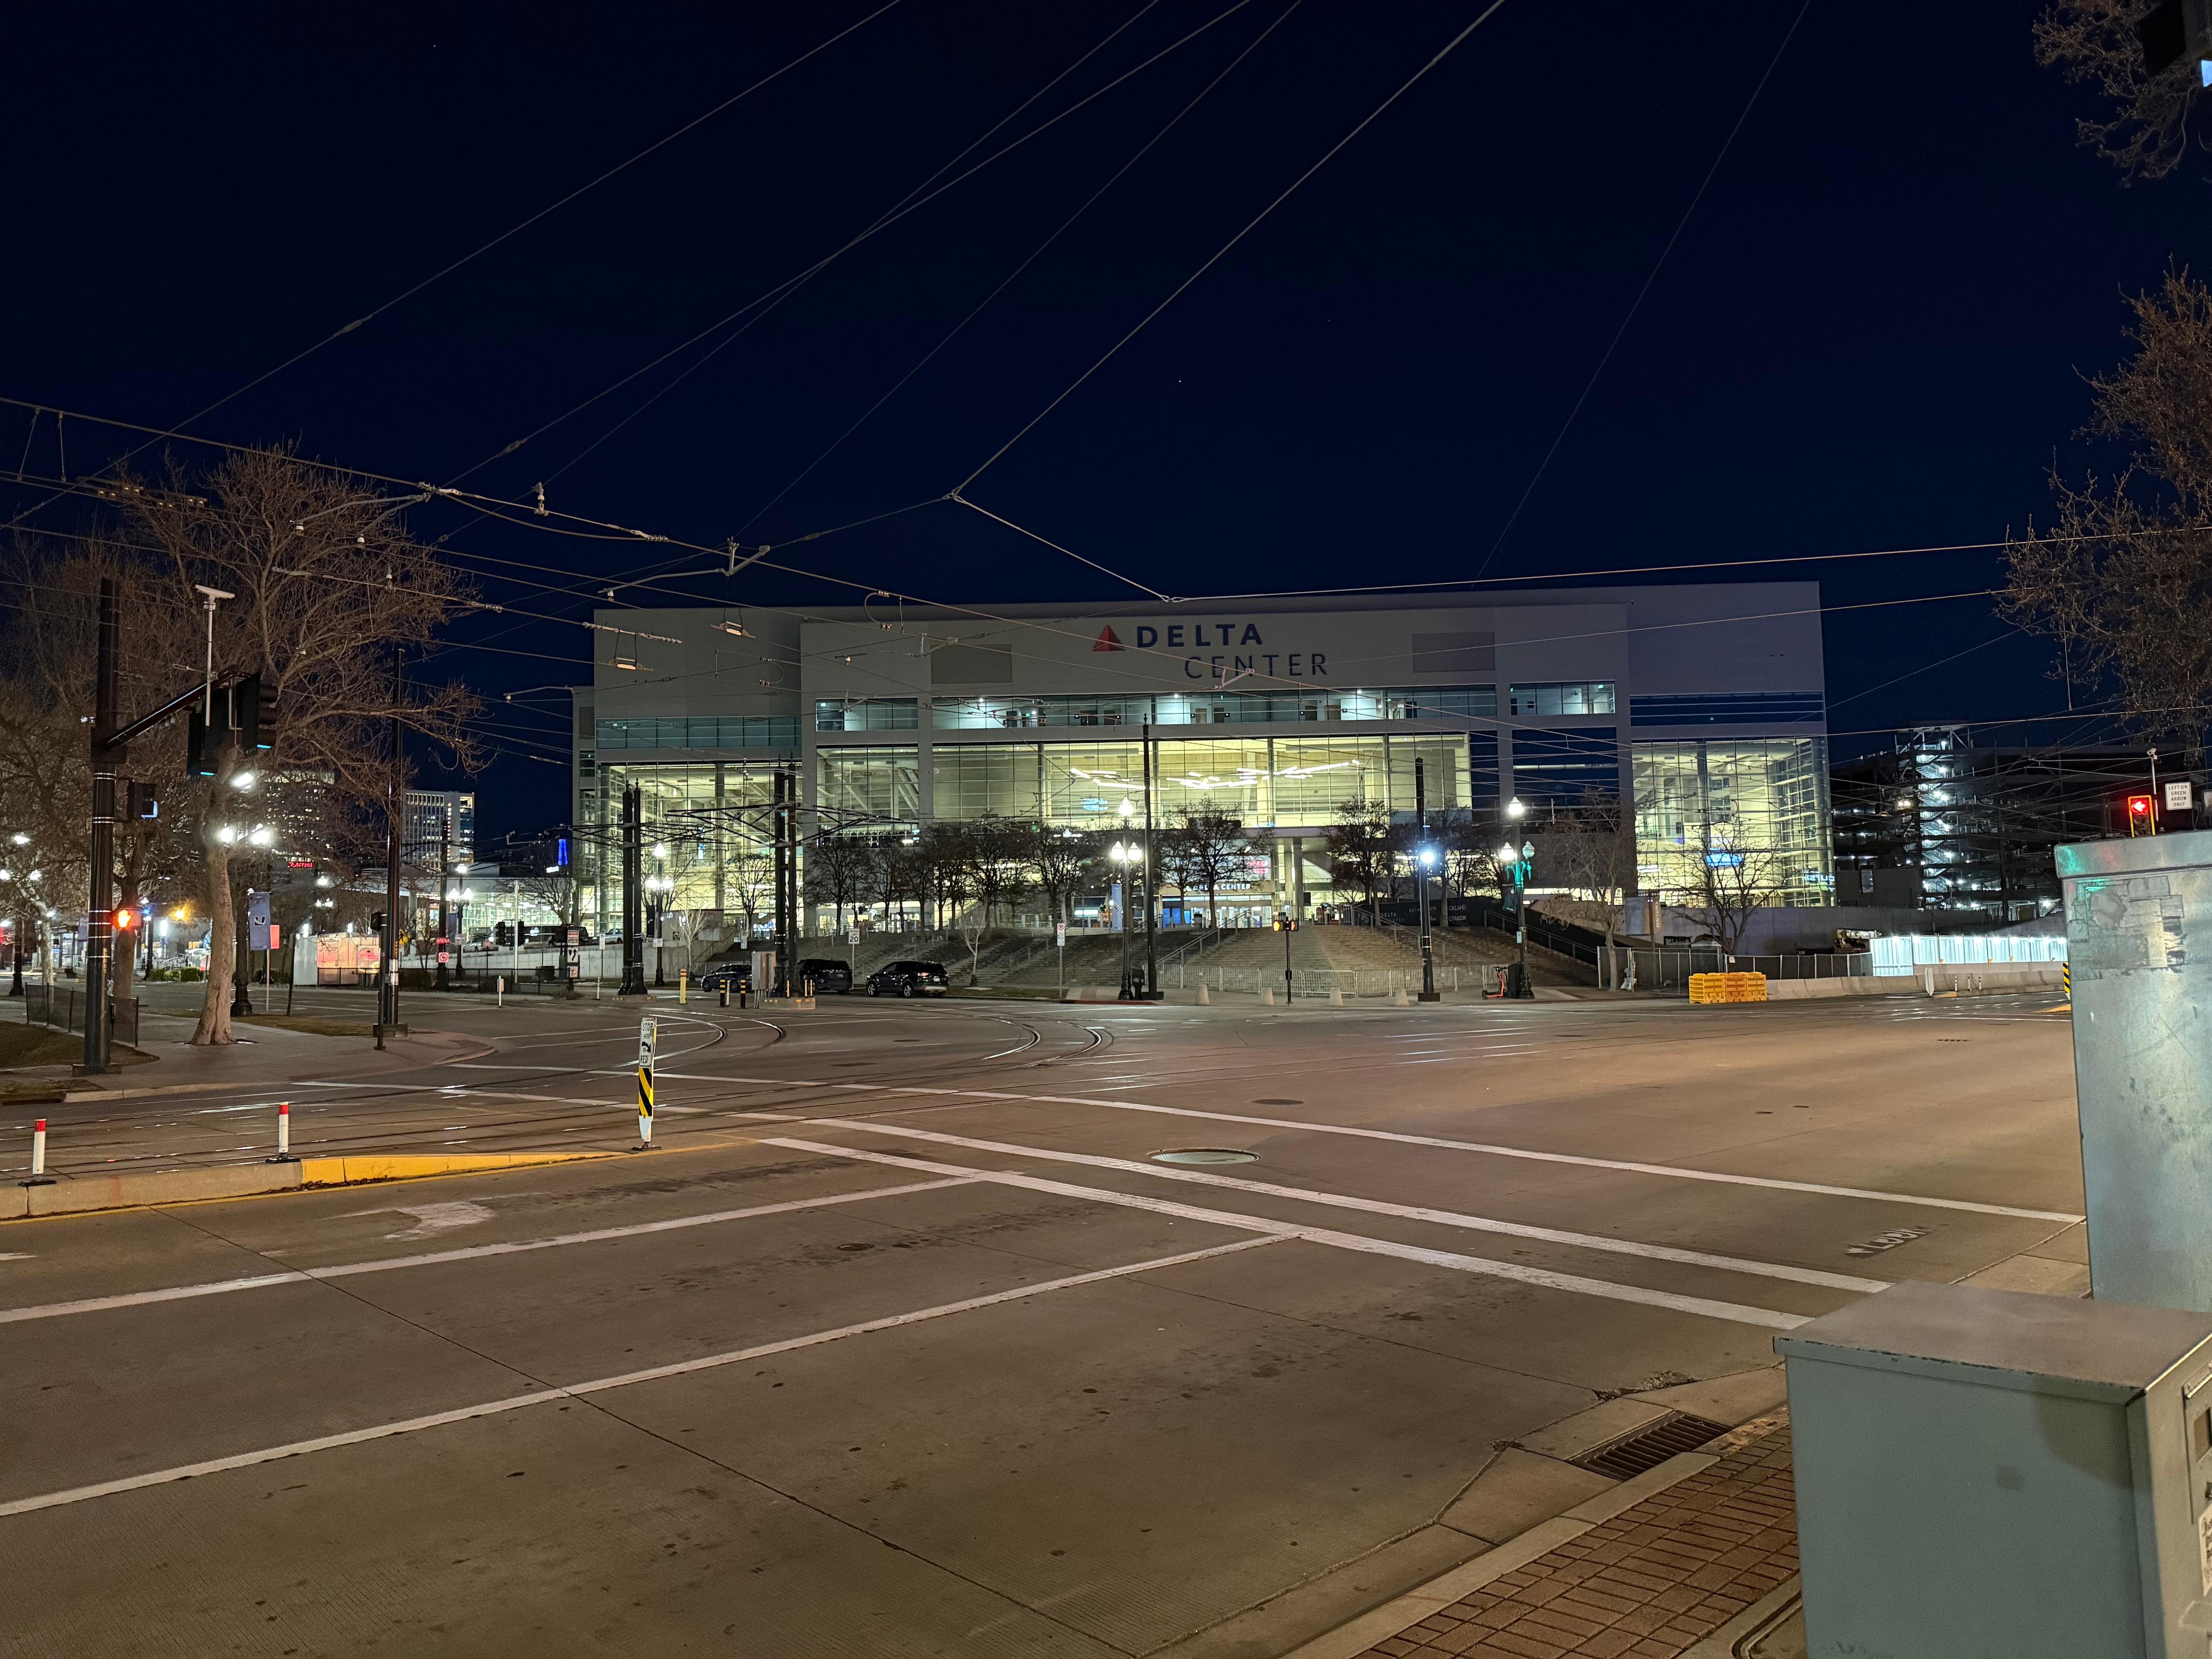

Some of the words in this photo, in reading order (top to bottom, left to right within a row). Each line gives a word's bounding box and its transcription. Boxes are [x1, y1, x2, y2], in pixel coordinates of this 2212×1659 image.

[1137, 623, 1263, 648] DELTA
[1185, 653, 1327, 679] CENTER
[643, 1023, 653, 1031] STOP
